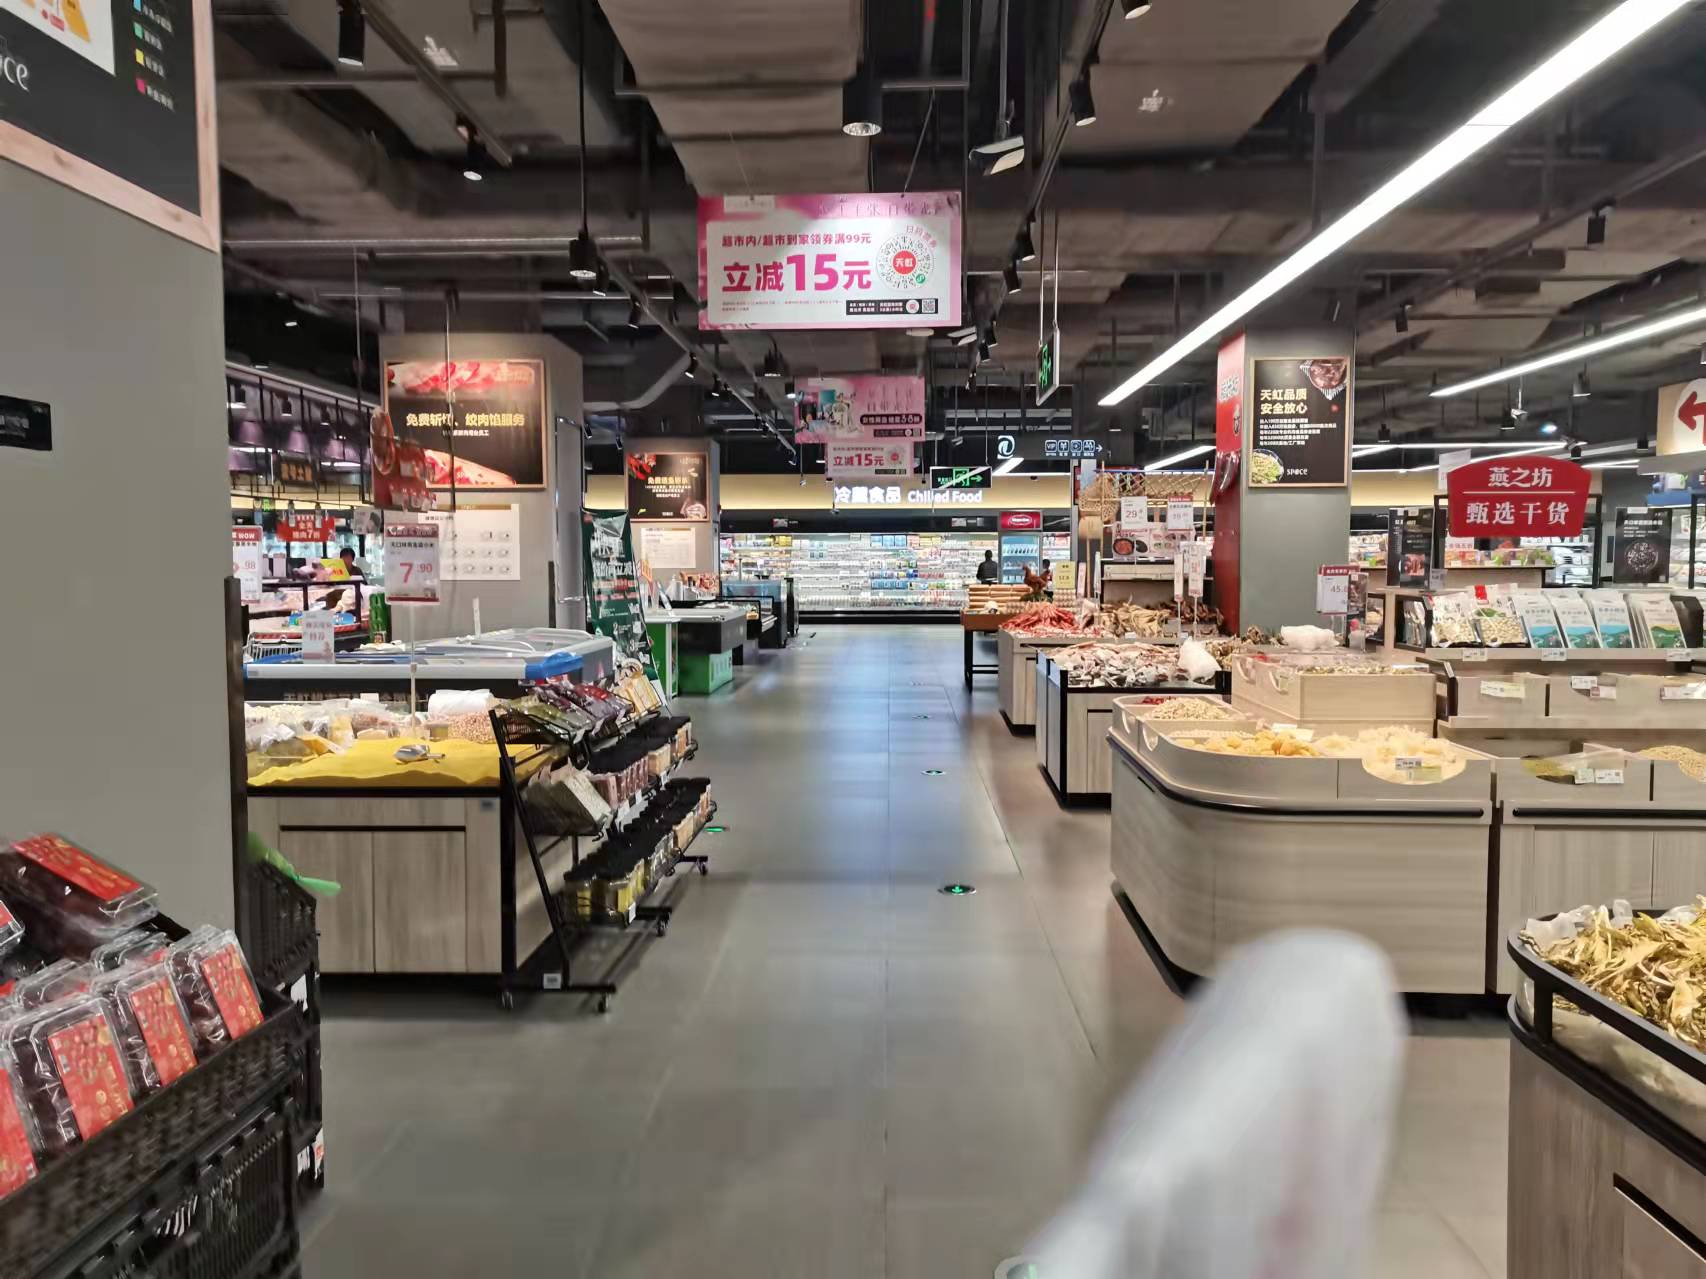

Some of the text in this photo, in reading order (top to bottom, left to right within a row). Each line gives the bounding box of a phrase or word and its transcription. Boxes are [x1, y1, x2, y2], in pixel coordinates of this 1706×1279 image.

[722, 253, 872, 292] 立减15元
[1260, 388, 1307, 401] 天虹品质
[1260, 402, 1308, 414] 安全放心
[833, 453, 885, 466] 立减15元
[1488, 467, 1553, 488] 燕之坊
[952, 490, 982, 503] Food
[1465, 501, 1569, 525] 甄选干货
